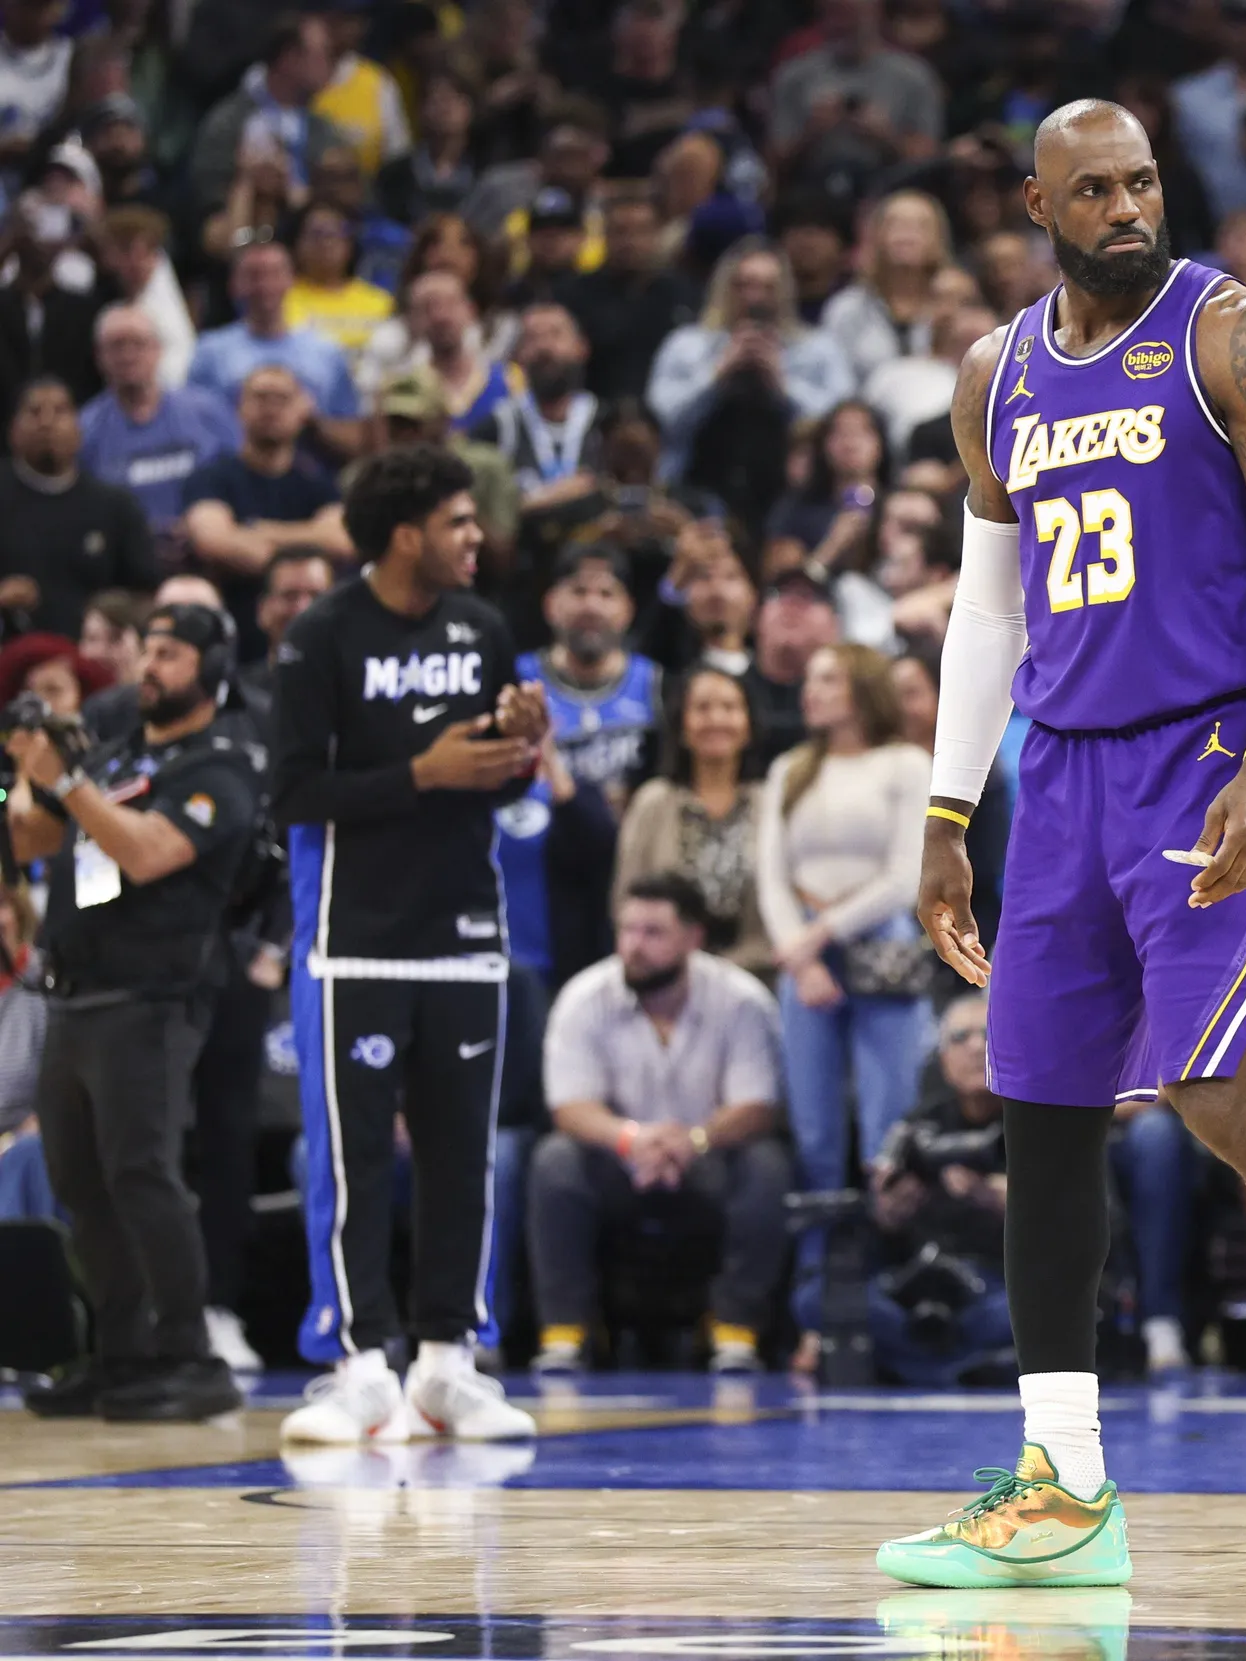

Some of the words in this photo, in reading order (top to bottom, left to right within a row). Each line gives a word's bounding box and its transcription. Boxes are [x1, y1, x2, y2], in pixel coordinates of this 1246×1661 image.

[1128, 351, 1170, 366] bibigo
[1006, 405, 1166, 494] LAKERS
[1033, 488, 1136, 614] 23
[364, 650, 482, 702] MAGIC
